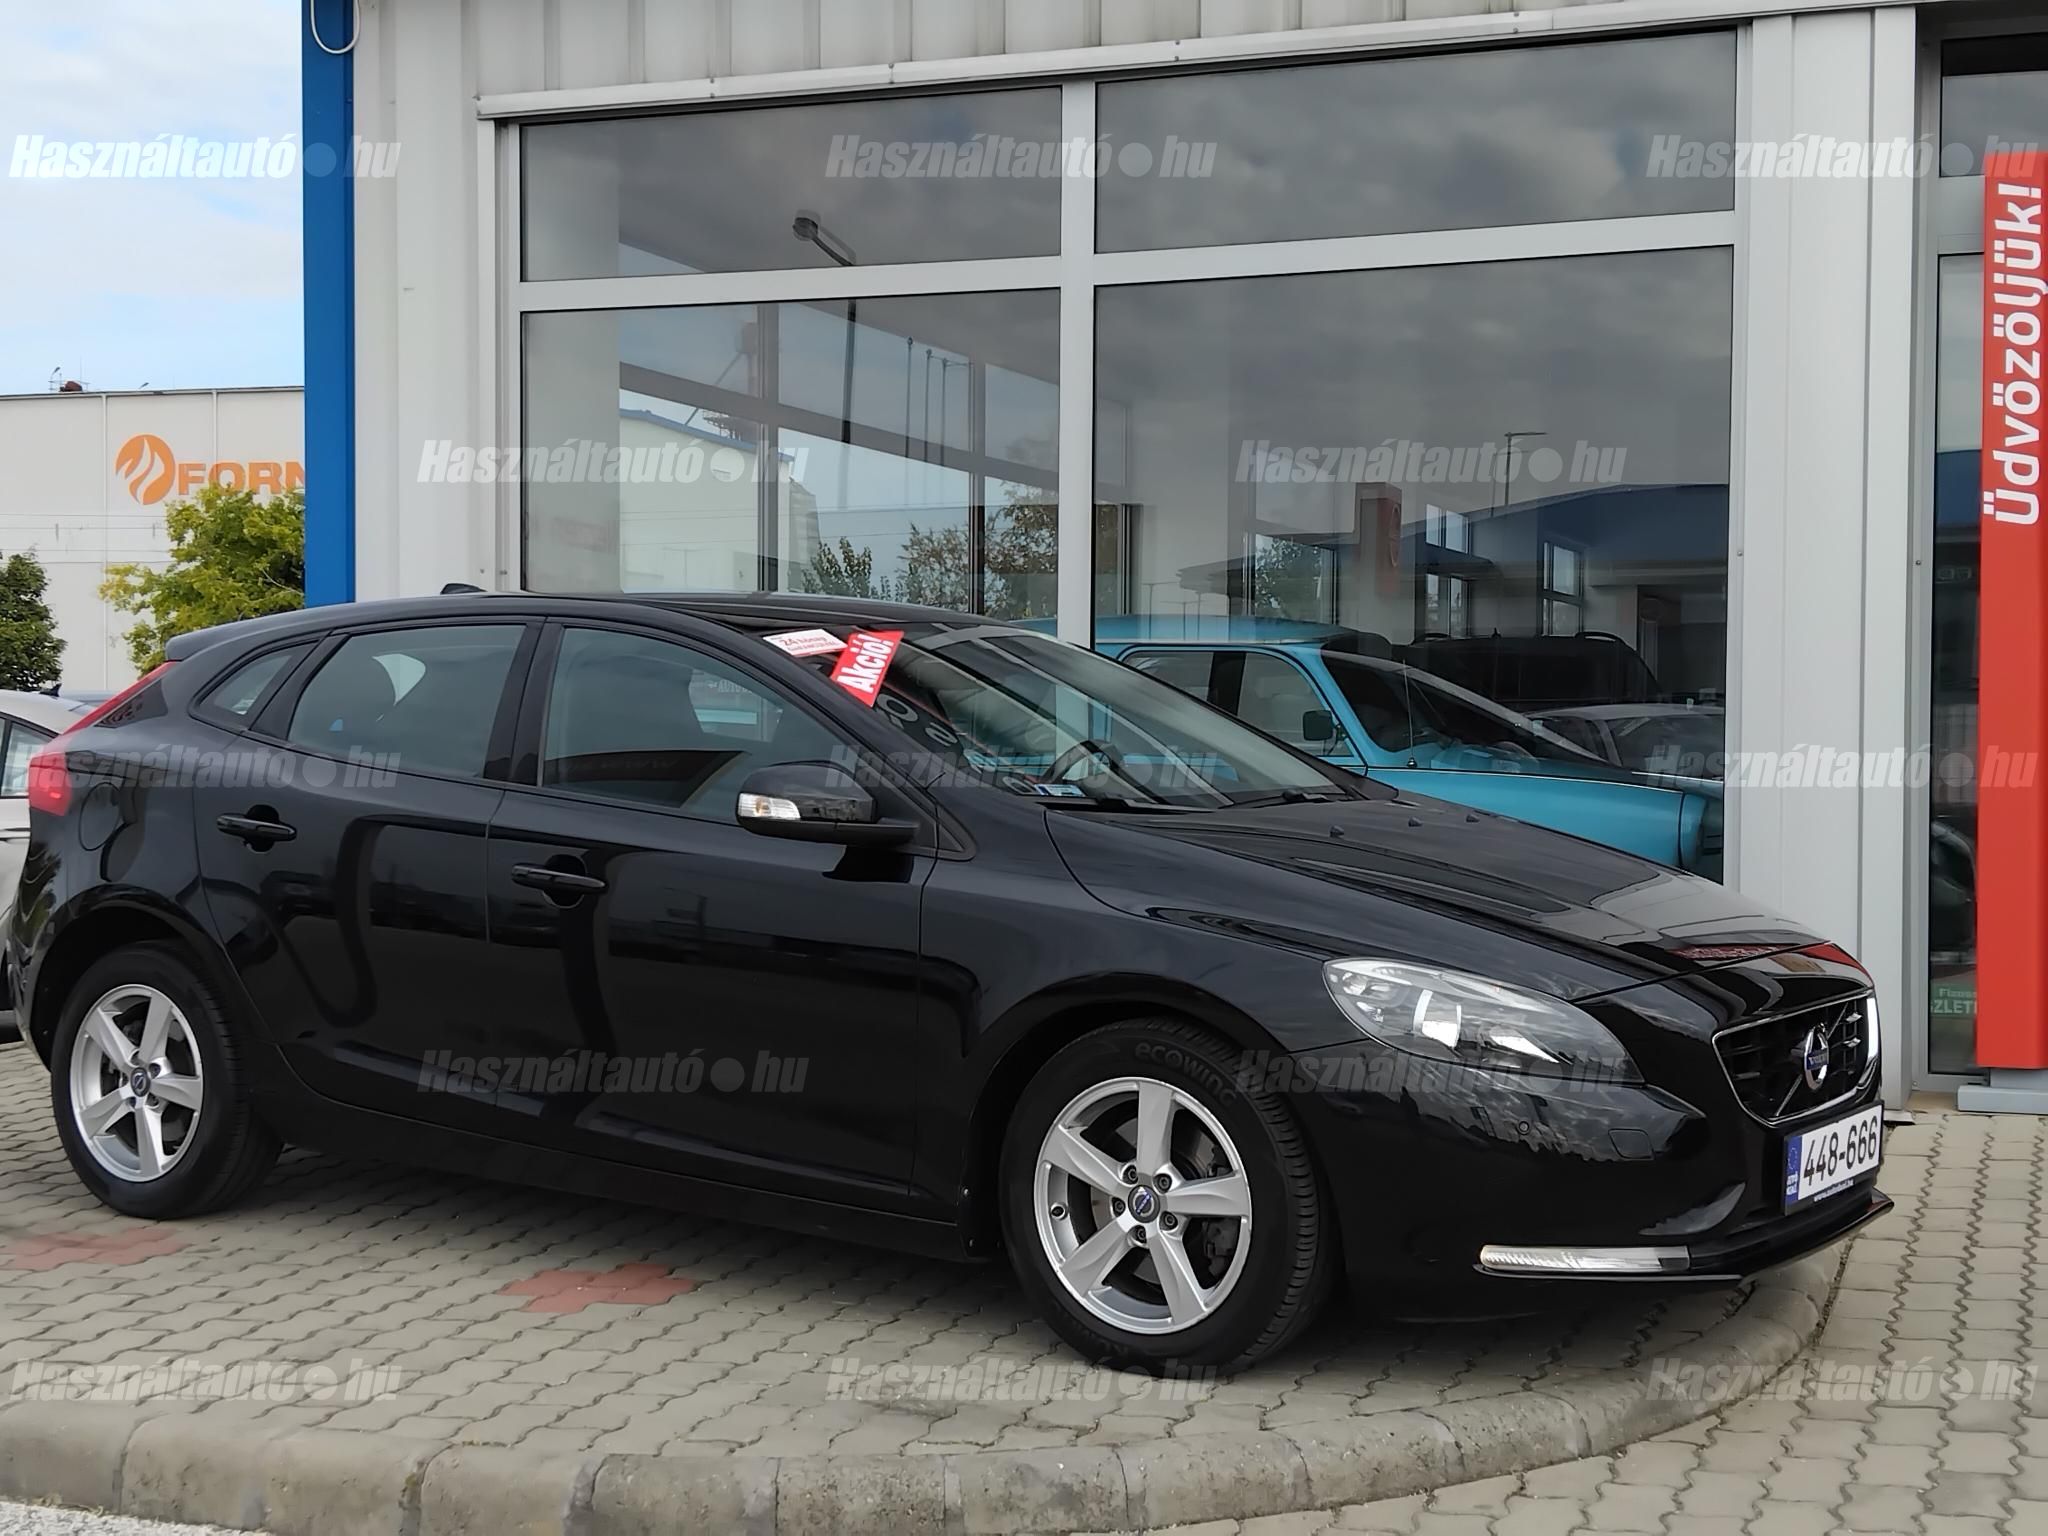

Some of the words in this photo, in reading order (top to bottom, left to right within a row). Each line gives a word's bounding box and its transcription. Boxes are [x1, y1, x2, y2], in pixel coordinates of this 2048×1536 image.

[1983, 183, 2045, 524] Üdvözöljük!
[836, 633, 894, 694] Akció!
[1803, 1115, 1878, 1187] 448-666
